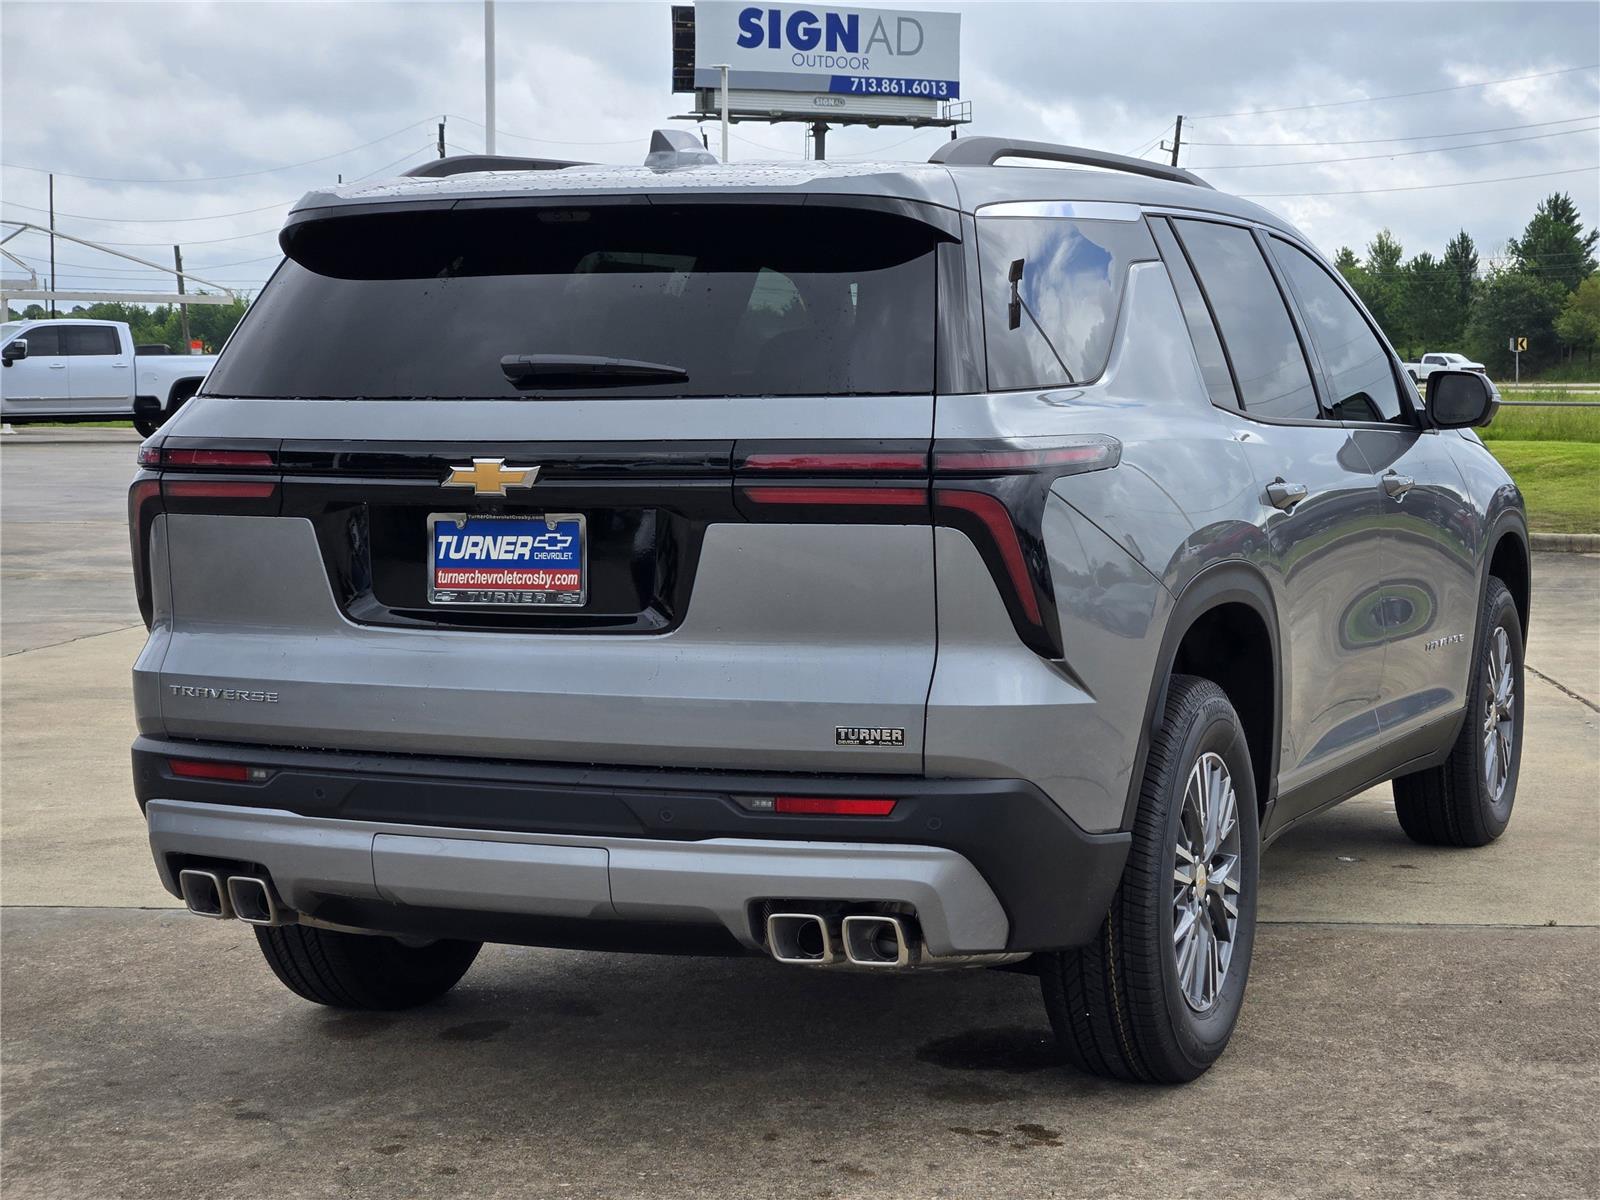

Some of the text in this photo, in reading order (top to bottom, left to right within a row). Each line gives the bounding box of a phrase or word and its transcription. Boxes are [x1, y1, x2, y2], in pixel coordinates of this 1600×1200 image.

[792, 52, 869, 70] OUTDOOR
[850, 77, 947, 95] 713.861.6013
[438, 536, 533, 560] TURNER
[534, 552, 572, 560] CHEVROLET
[438, 570, 577, 588] turnerchevroletcrosby.com
[467, 592, 546, 603] TURNER
[169, 684, 279, 703] TRAVERSE
[838, 729, 902, 740] TURNER
